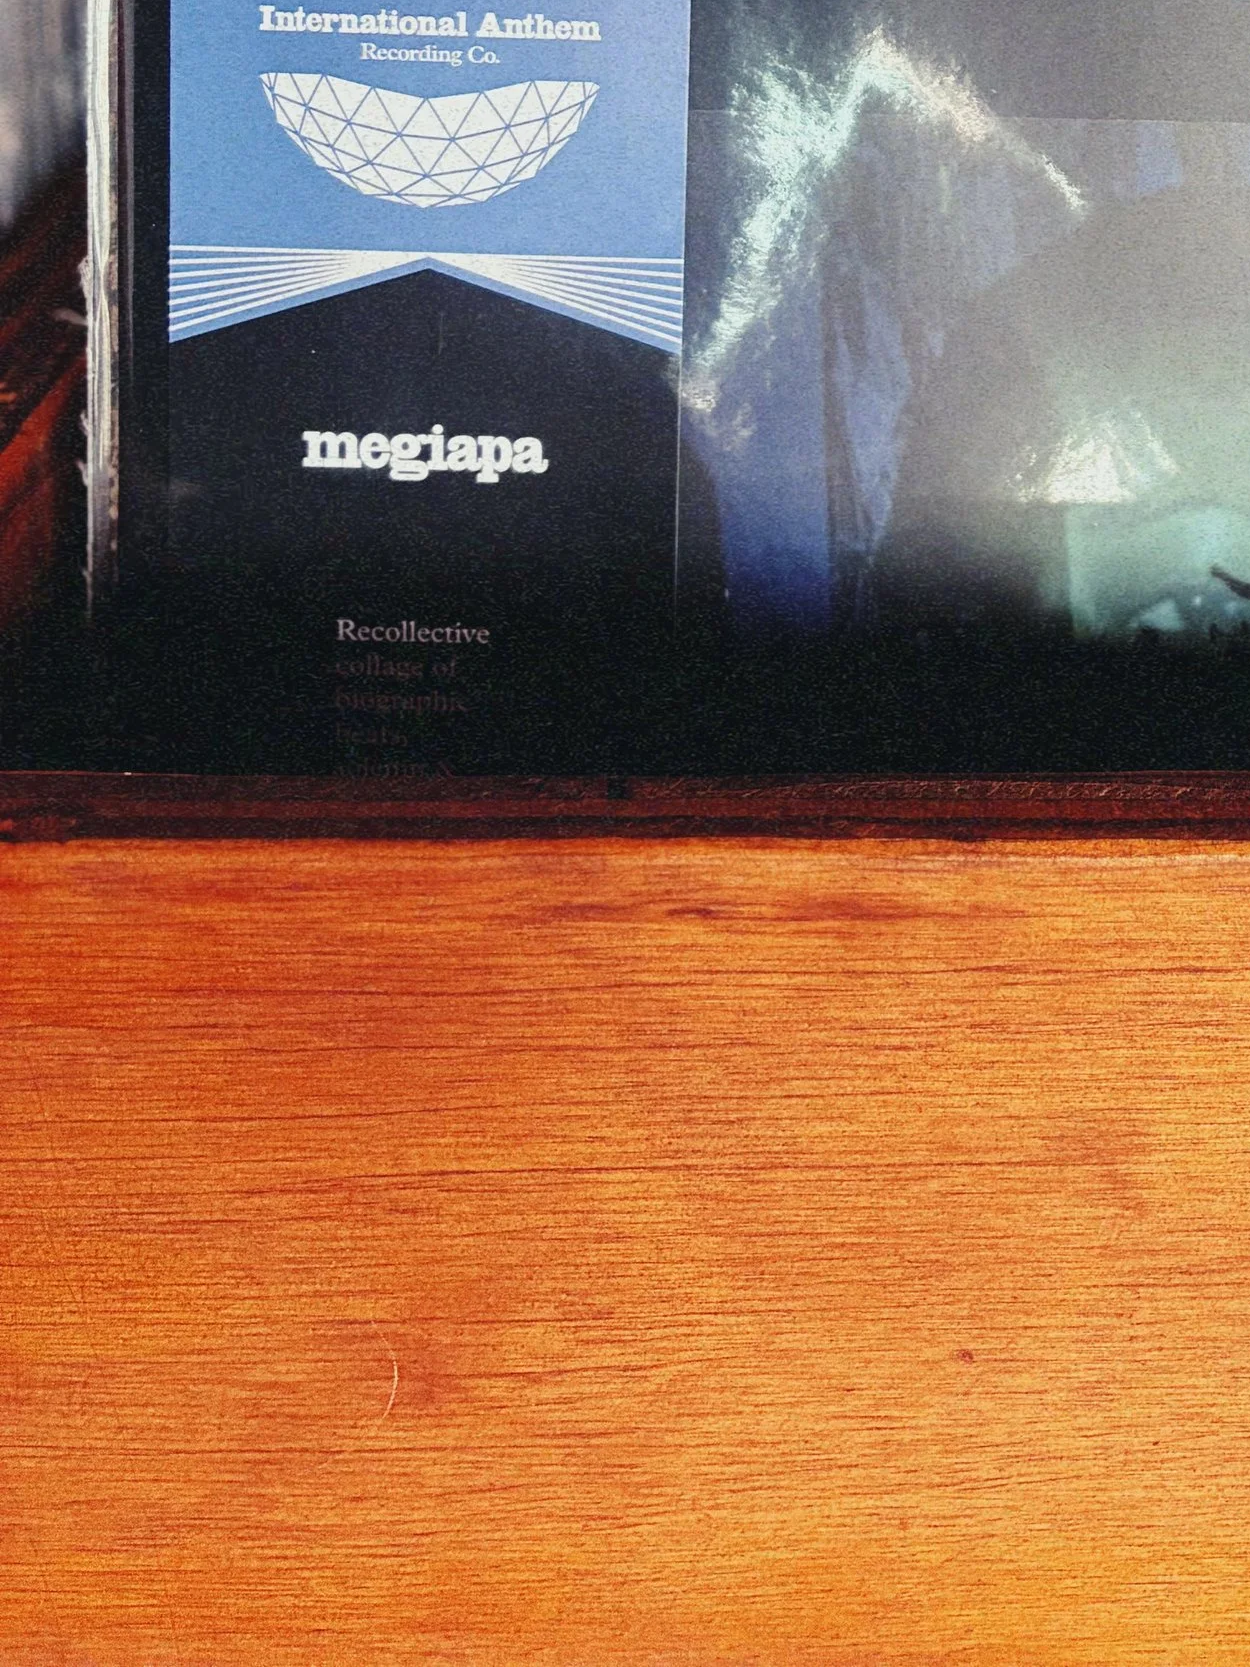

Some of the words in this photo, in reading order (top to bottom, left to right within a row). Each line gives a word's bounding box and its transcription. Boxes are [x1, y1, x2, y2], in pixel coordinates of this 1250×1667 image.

[259, 5, 468, 38] International
[476, 11, 602, 41] Anthem
[360, 42, 462, 66] Recording
[467, 45, 501, 65] Co.
[302, 423, 549, 483] megiapa
[336, 618, 490, 644] Recollective
[335, 653, 424, 681] collage
